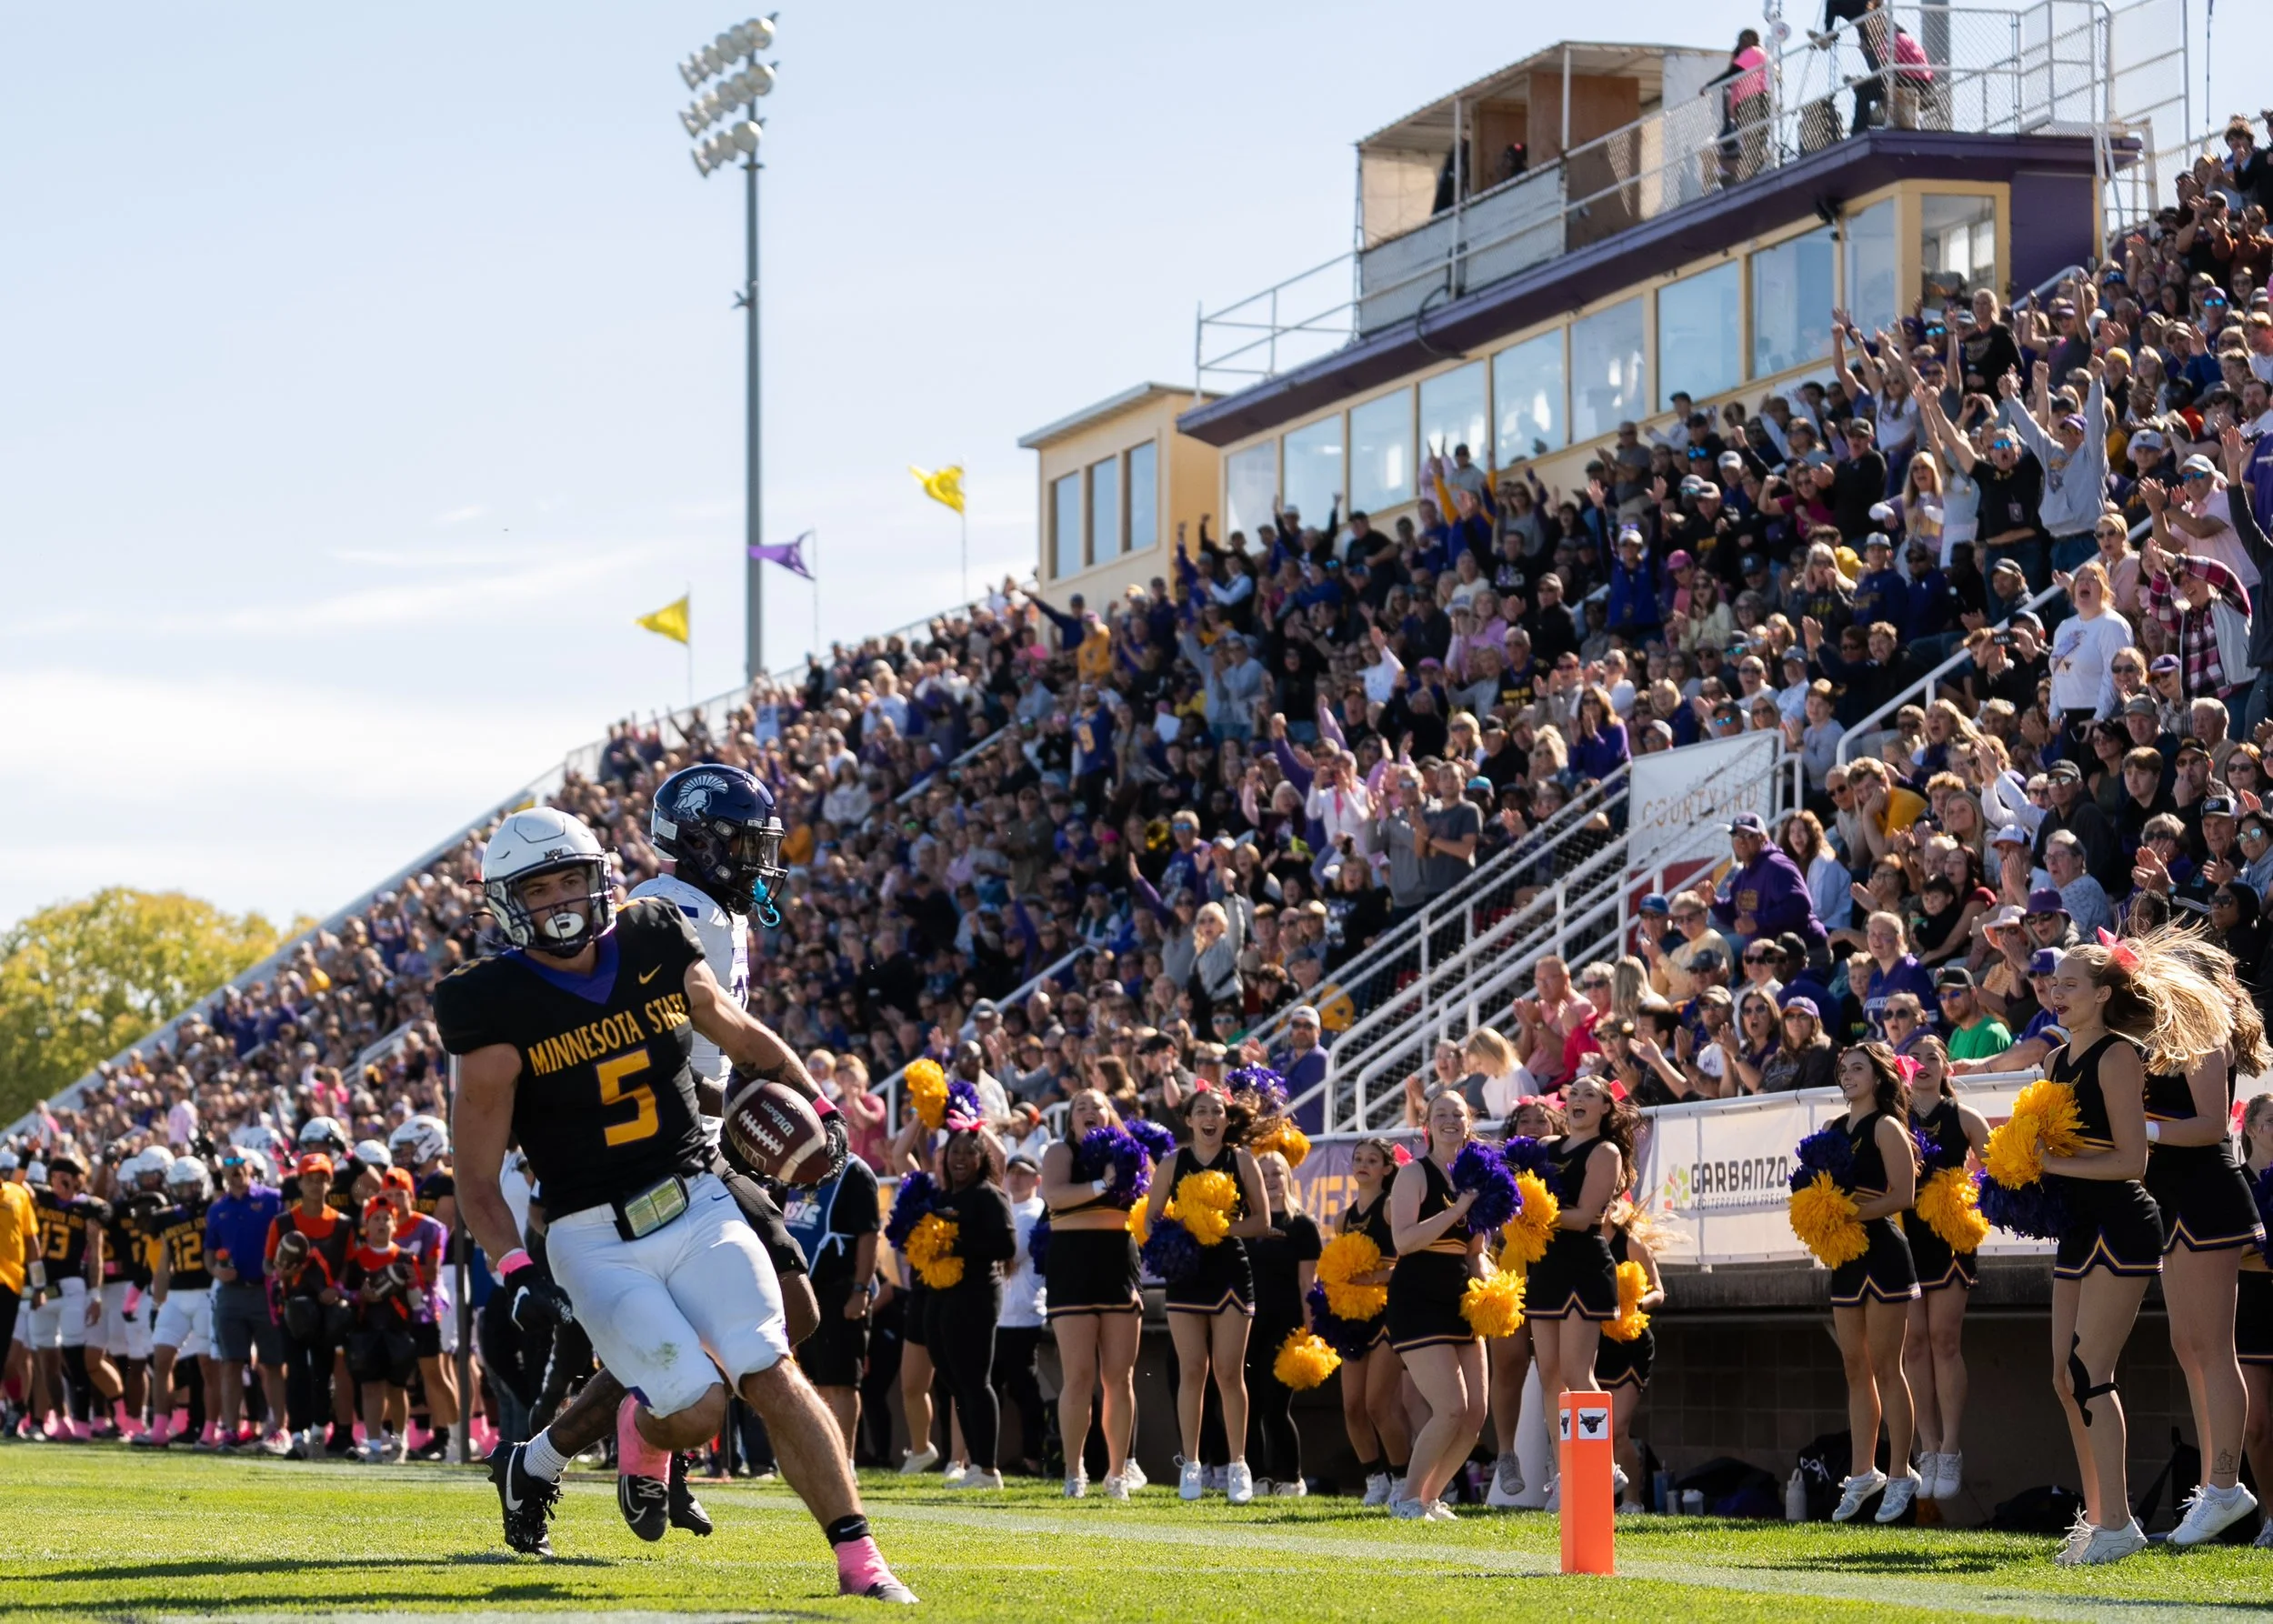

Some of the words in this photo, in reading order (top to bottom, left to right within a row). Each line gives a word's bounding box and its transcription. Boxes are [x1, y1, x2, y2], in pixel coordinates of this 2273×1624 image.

[527, 1009, 646, 1077] MINNESOTA
[645, 992, 689, 1034] STATE
[596, 1048, 660, 1147] 5
[760, 1099, 796, 1138] Wilson
[1690, 1155, 1788, 1195] GARBANZO
[1690, 1195, 1757, 1212] MEDITERRANEAN
[1759, 1192, 1787, 1206] FRESH
[40, 1220, 70, 1260] 13
[173, 1230, 204, 1272] 12
